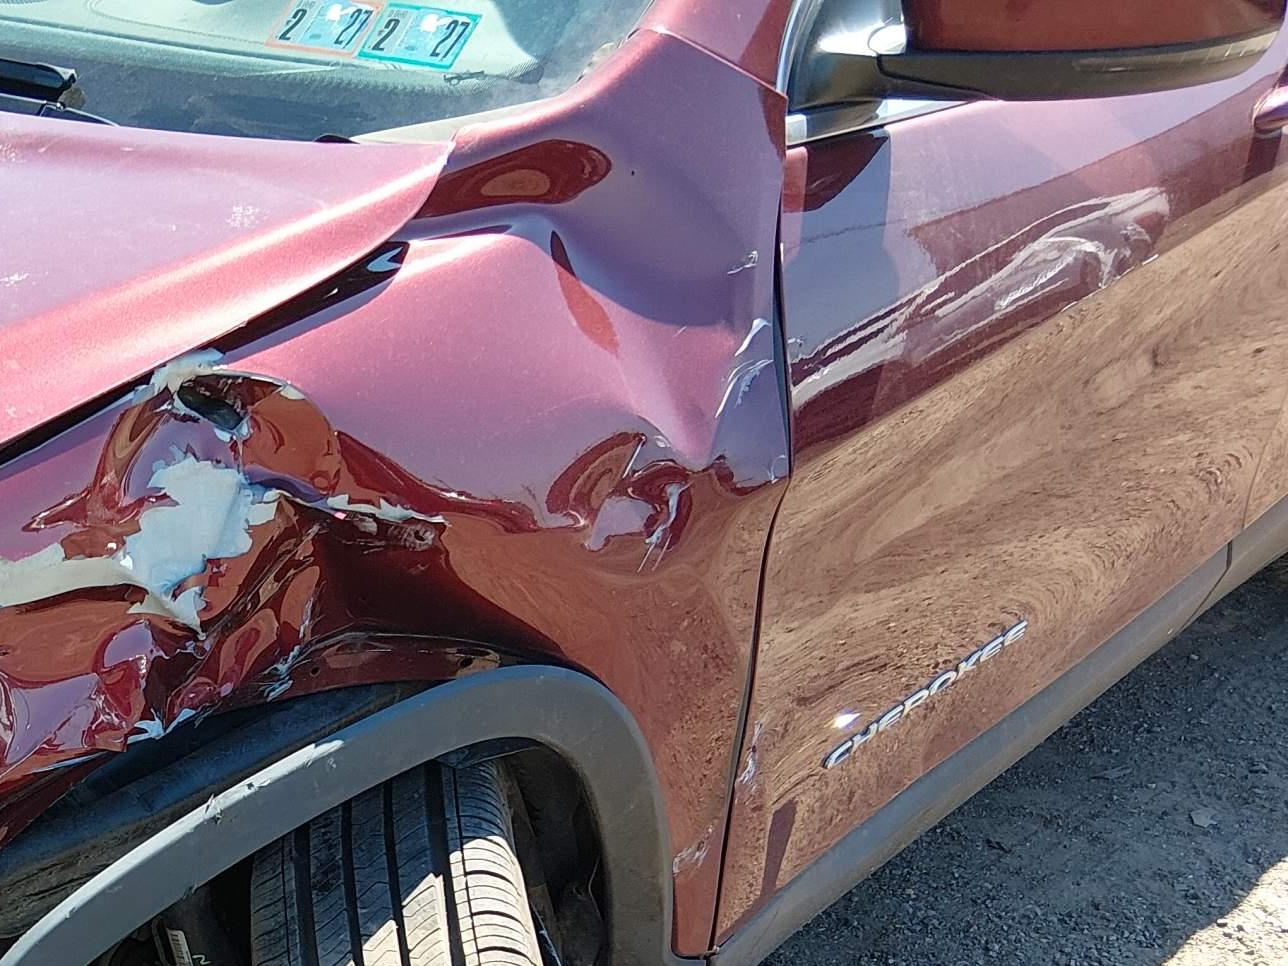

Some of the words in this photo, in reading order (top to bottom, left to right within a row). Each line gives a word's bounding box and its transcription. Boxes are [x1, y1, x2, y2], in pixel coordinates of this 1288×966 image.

[279, 8, 307, 40] 2
[334, 8, 373, 48] 27
[372, 18, 400, 51] 2
[429, 19, 471, 58] 27
[823, 620, 1028, 769] CHEROKEE
